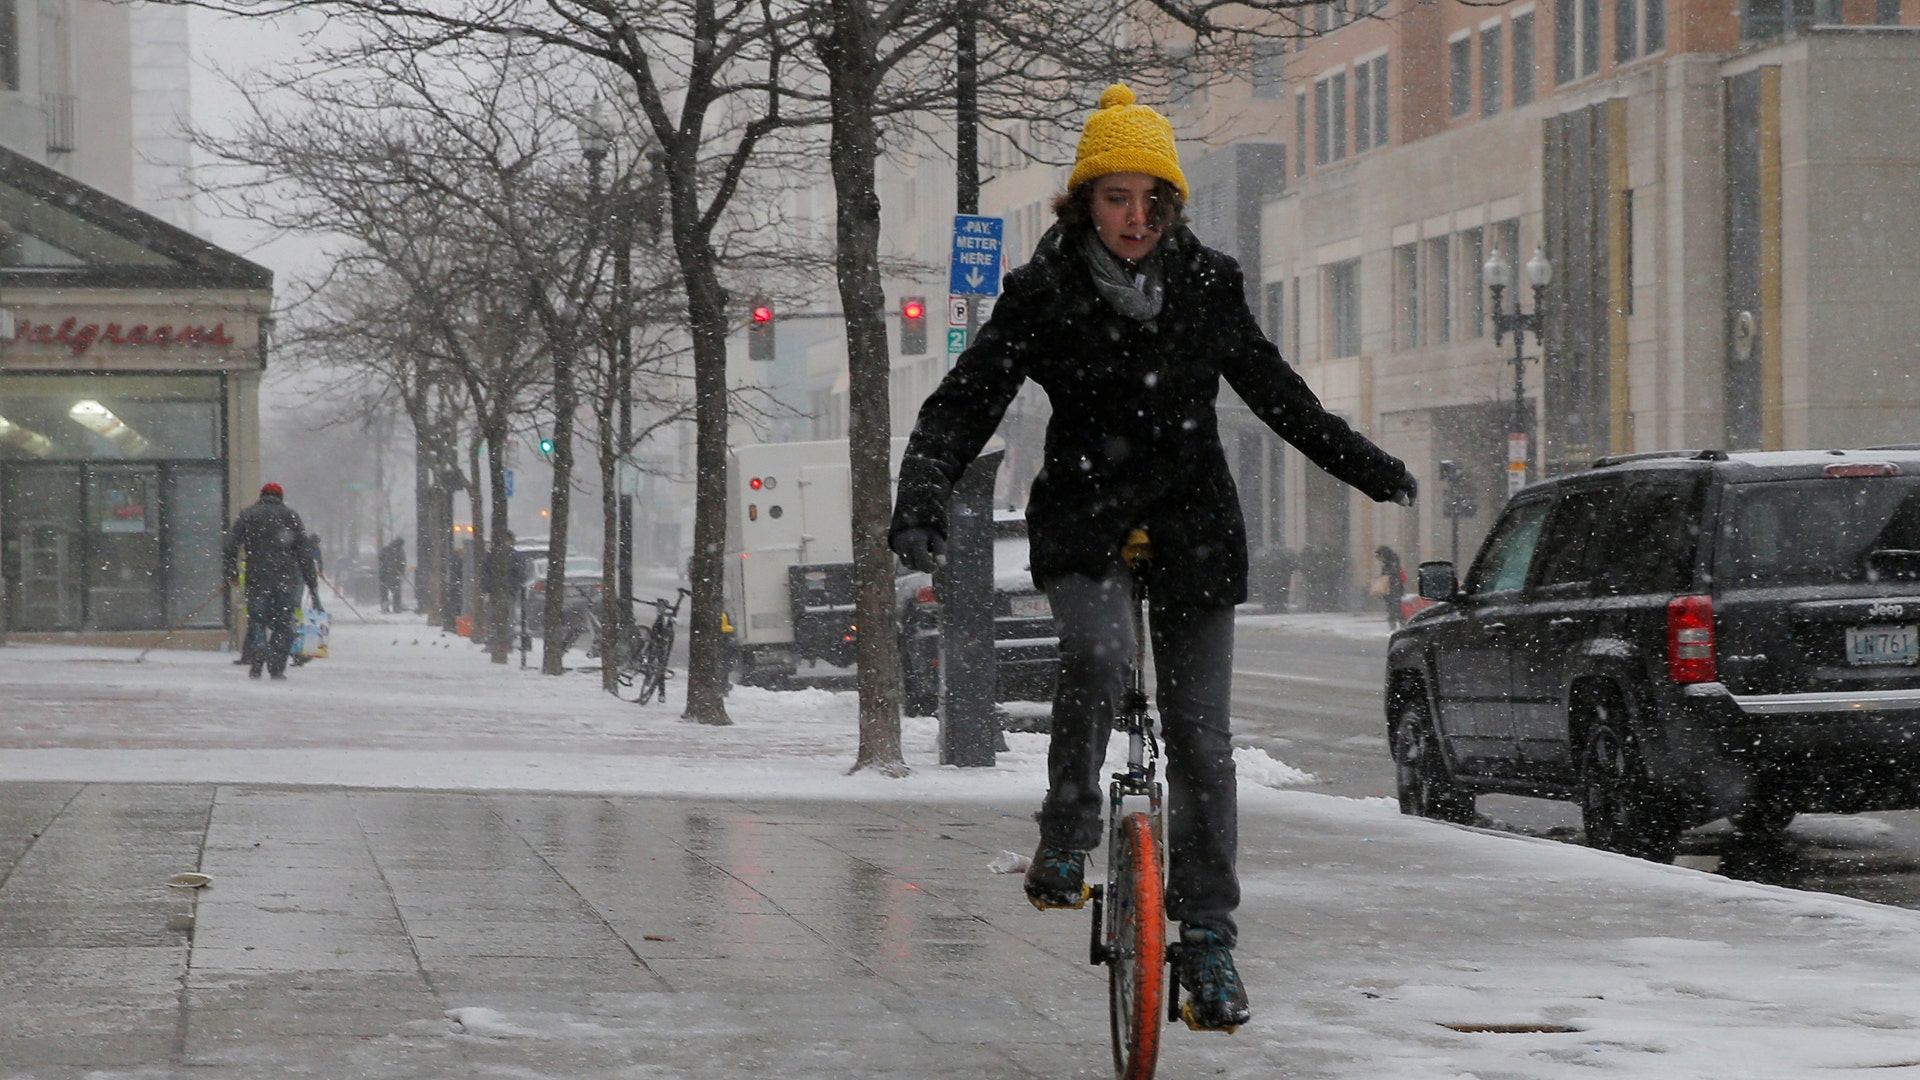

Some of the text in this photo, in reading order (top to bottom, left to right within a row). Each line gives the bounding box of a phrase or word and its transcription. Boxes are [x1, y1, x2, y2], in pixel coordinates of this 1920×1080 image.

[967, 221, 991, 234] PAY
[957, 236, 998, 250] METER
[960, 252, 993, 265] HERE
[950, 332, 963, 347] 2
[1868, 602, 1903, 617] Jeep
[1879, 634, 1907, 653] 761
